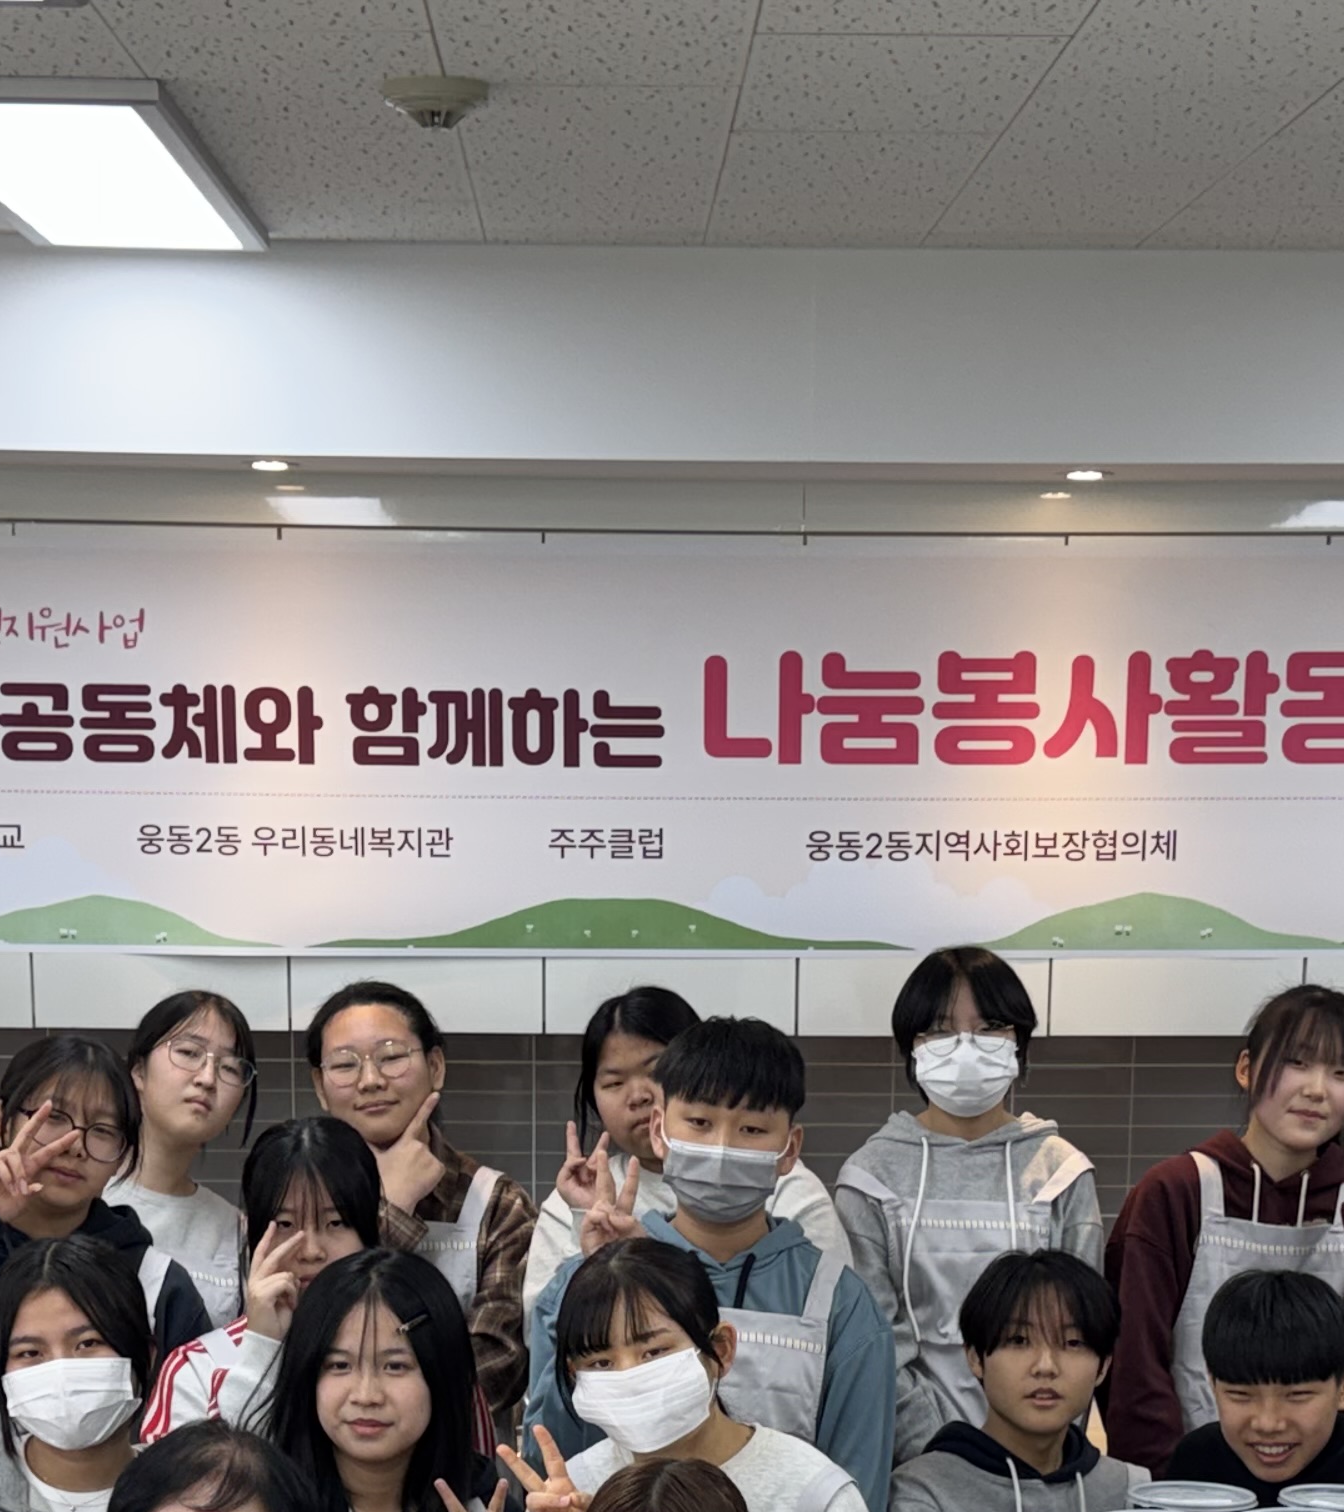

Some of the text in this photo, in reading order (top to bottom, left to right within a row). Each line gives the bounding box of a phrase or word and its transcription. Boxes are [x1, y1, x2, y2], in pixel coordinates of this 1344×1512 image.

[344, 684, 666, 769] 함께하는
[136, 822, 455, 859] 웅동2동 우리동네복지관
[547, 827, 665, 860] 주주클럽
[805, 828, 1178, 863] 웅동2동지역사회보장협의체
